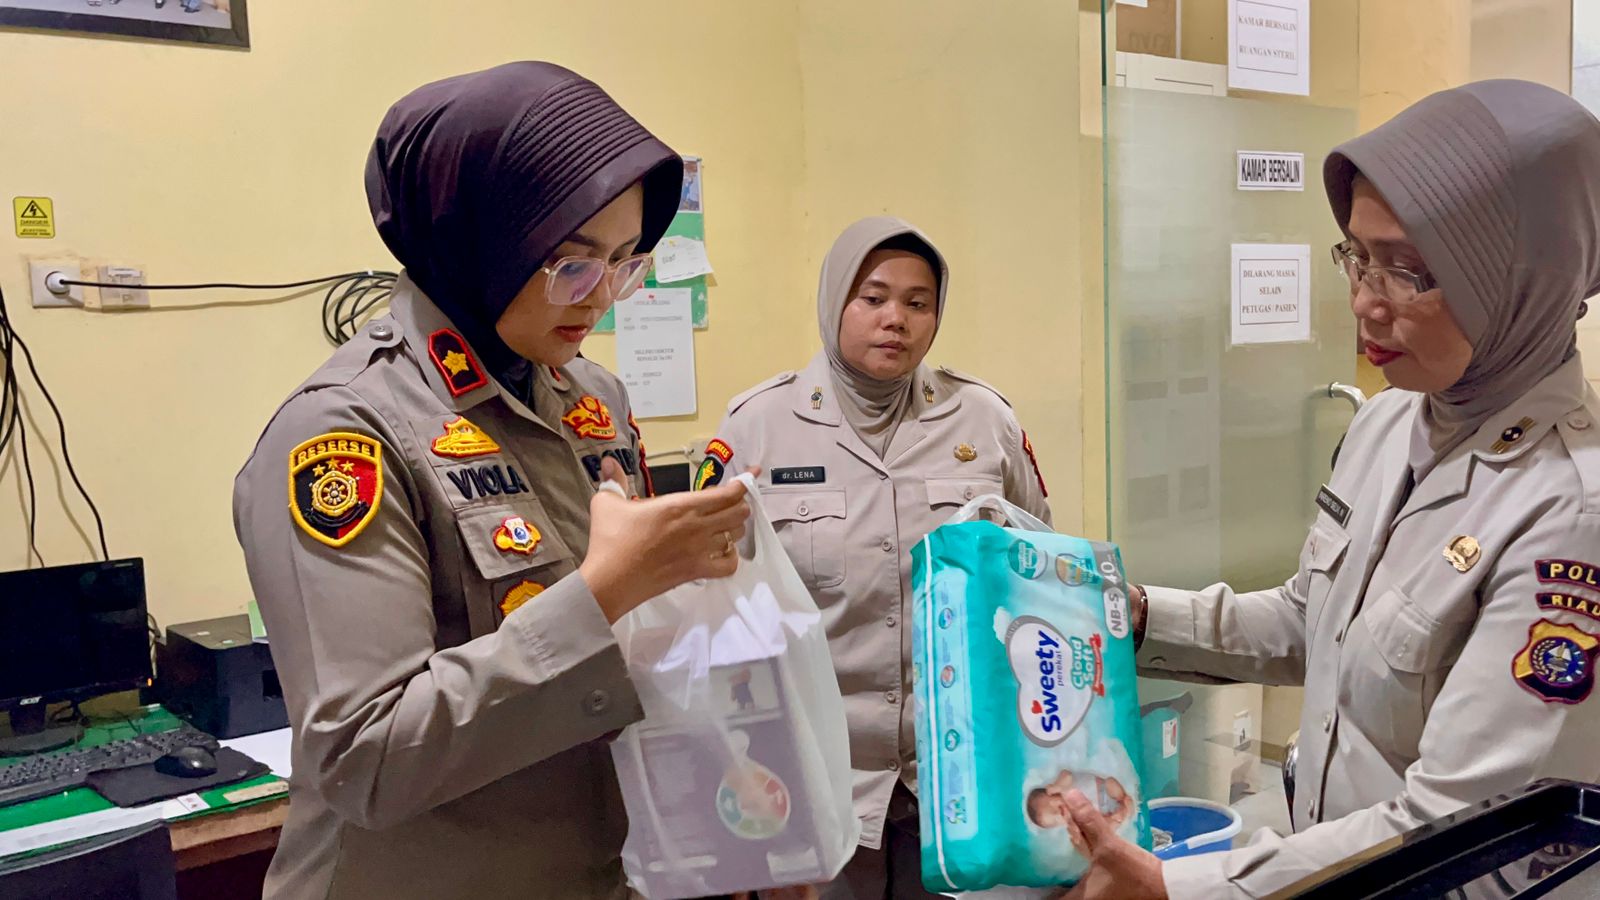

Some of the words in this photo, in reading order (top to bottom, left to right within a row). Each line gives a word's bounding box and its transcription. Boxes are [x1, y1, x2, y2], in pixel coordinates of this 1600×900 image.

[1241, 158, 1267, 182] KAMAR
[1268, 159, 1300, 182] BERSALIN
[1243, 269, 1275, 278] DILARANG
[1276, 269, 1296, 278] MASUK
[1259, 286, 1282, 295] SELAIN
[298, 440, 371, 462] RESERSE
[446, 465, 530, 500] VIOLA
[794, 471, 815, 479] LENA
[1109, 593, 1123, 632] NB-S
[1055, 650, 1064, 687] perekat
[1070, 638, 1084, 689] Cloud
[1083, 647, 1093, 683] Soft
[1036, 630, 1062, 733] Sweety
